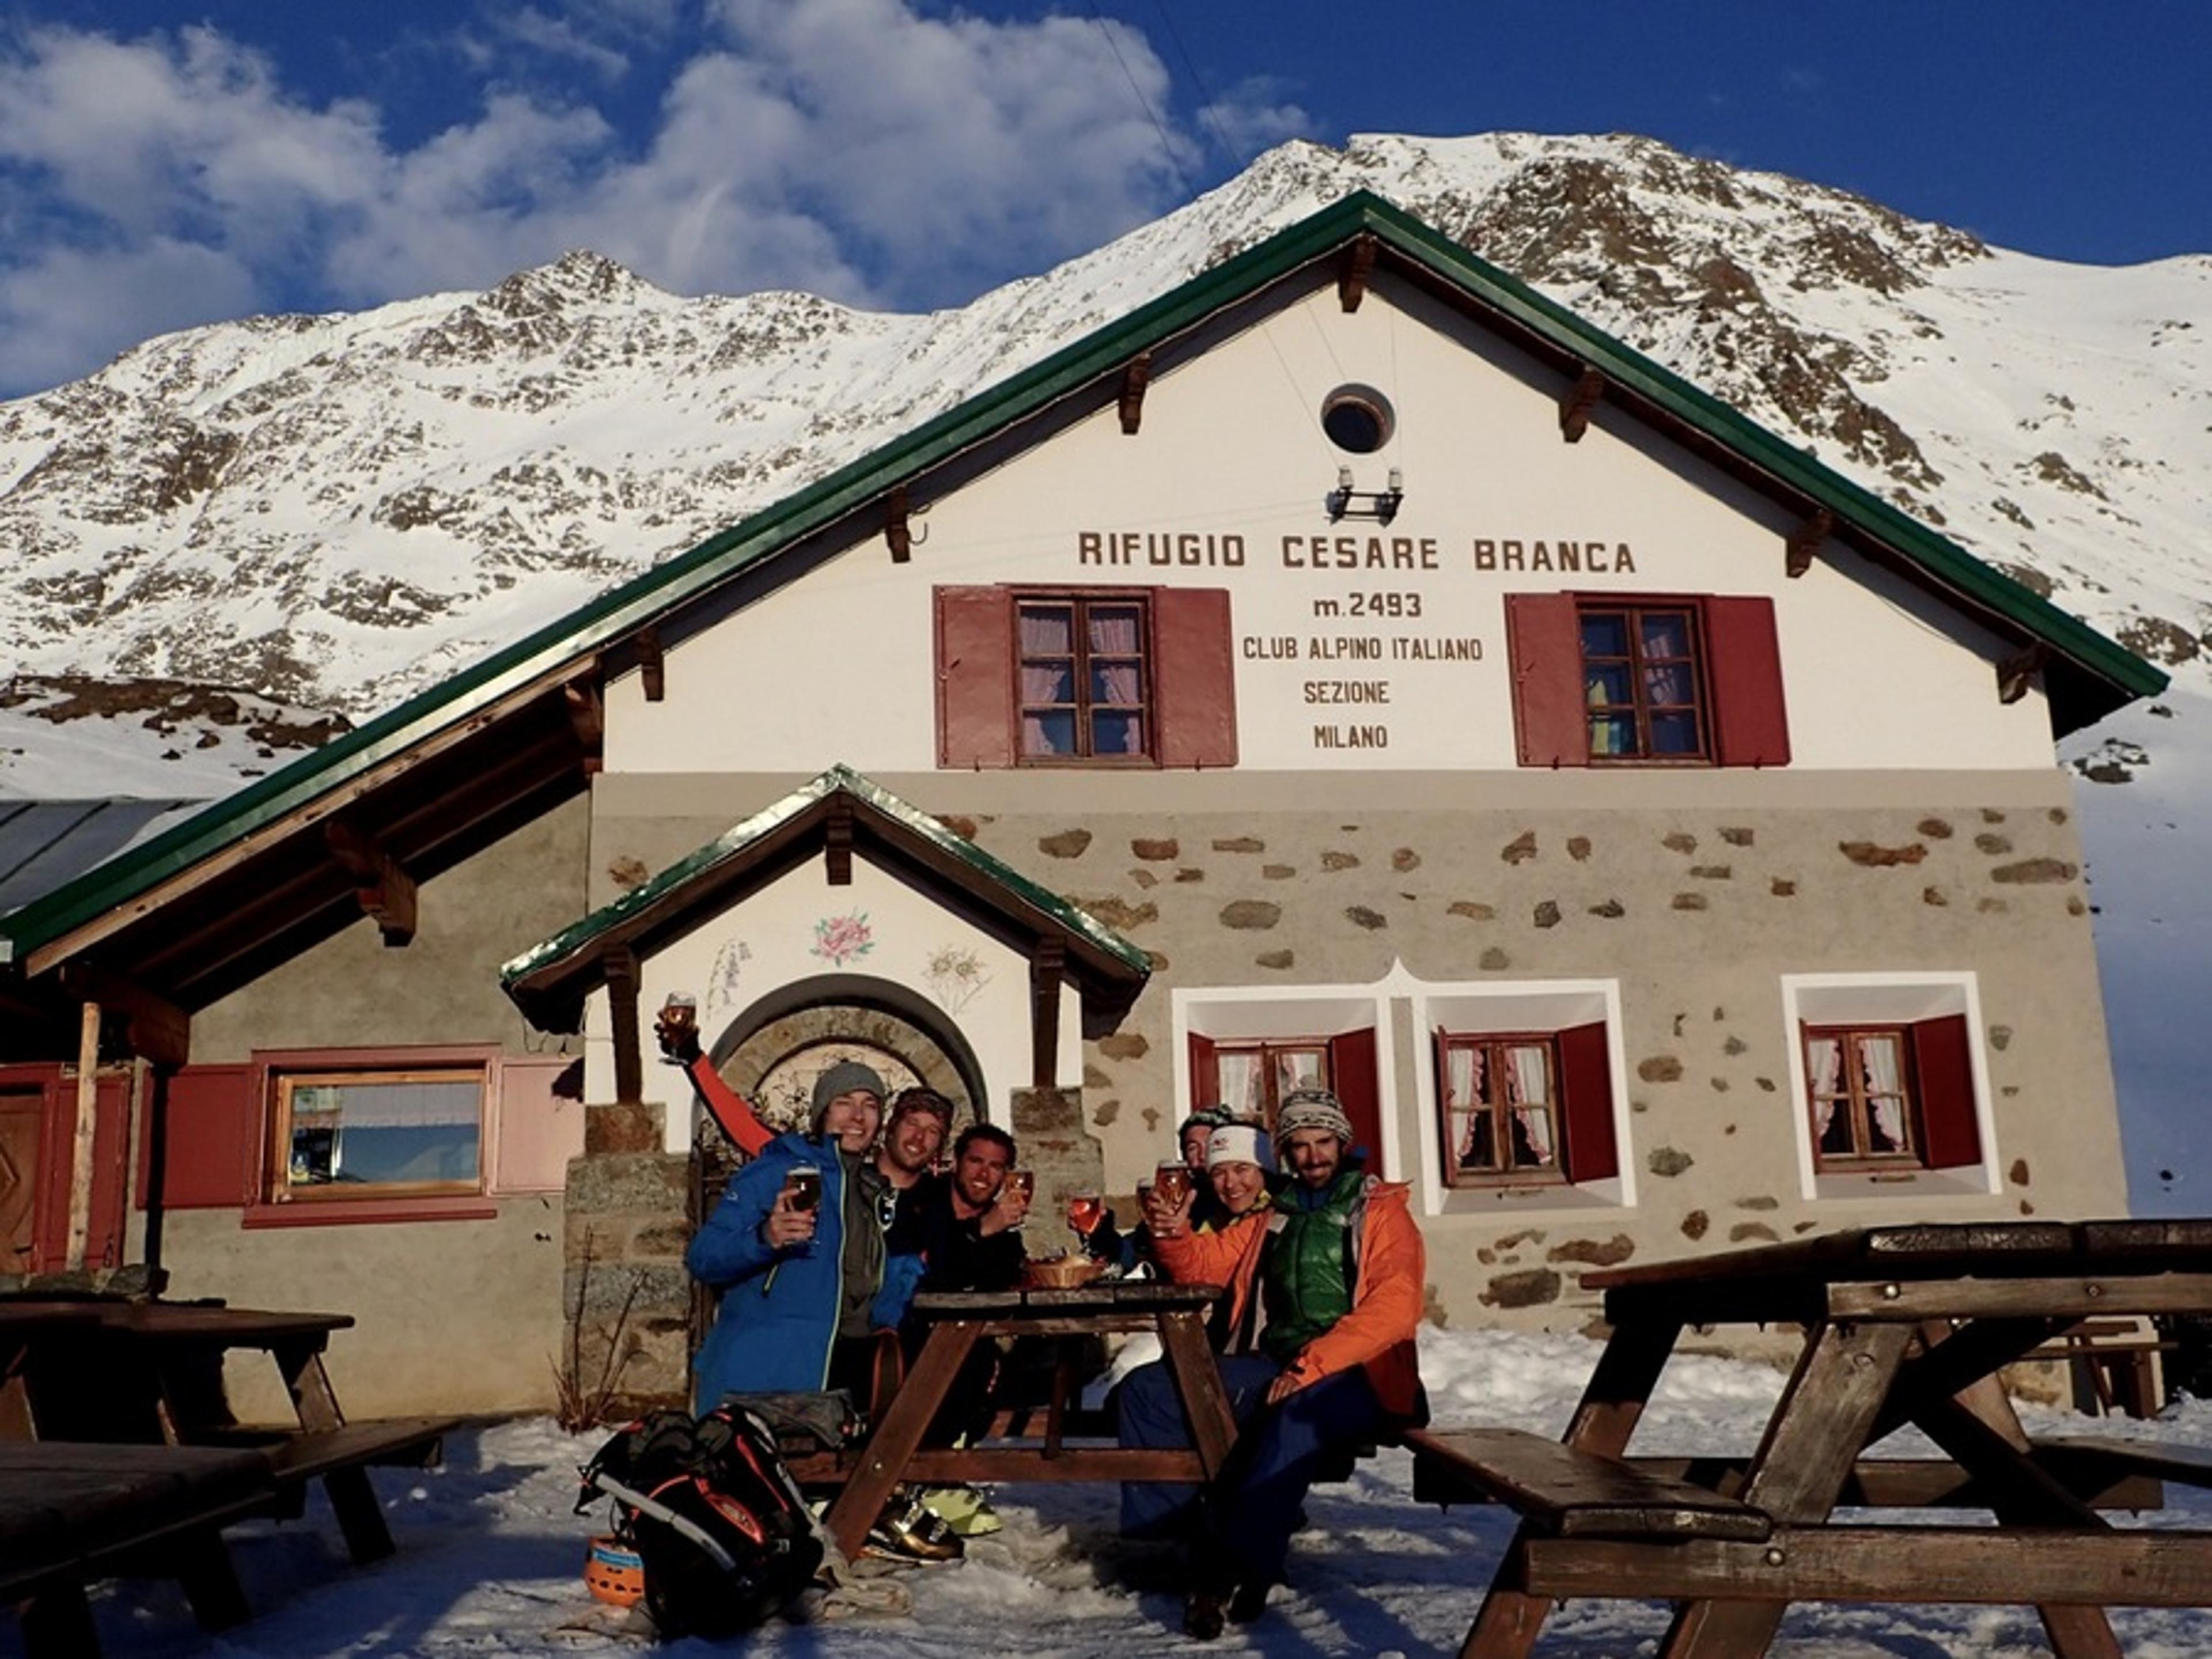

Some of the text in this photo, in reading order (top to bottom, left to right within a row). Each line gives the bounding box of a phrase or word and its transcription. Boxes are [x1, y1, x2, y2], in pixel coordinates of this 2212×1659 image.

[1079, 532, 1636, 574] RIFUGIO CESARE BRANCA
[1313, 592, 1422, 618] m.2493
[1243, 636, 1483, 661] CLUB ALPINO ITALIANO
[1304, 680, 1390, 704] SEZIONE
[1313, 725, 1388, 749] MILANO
